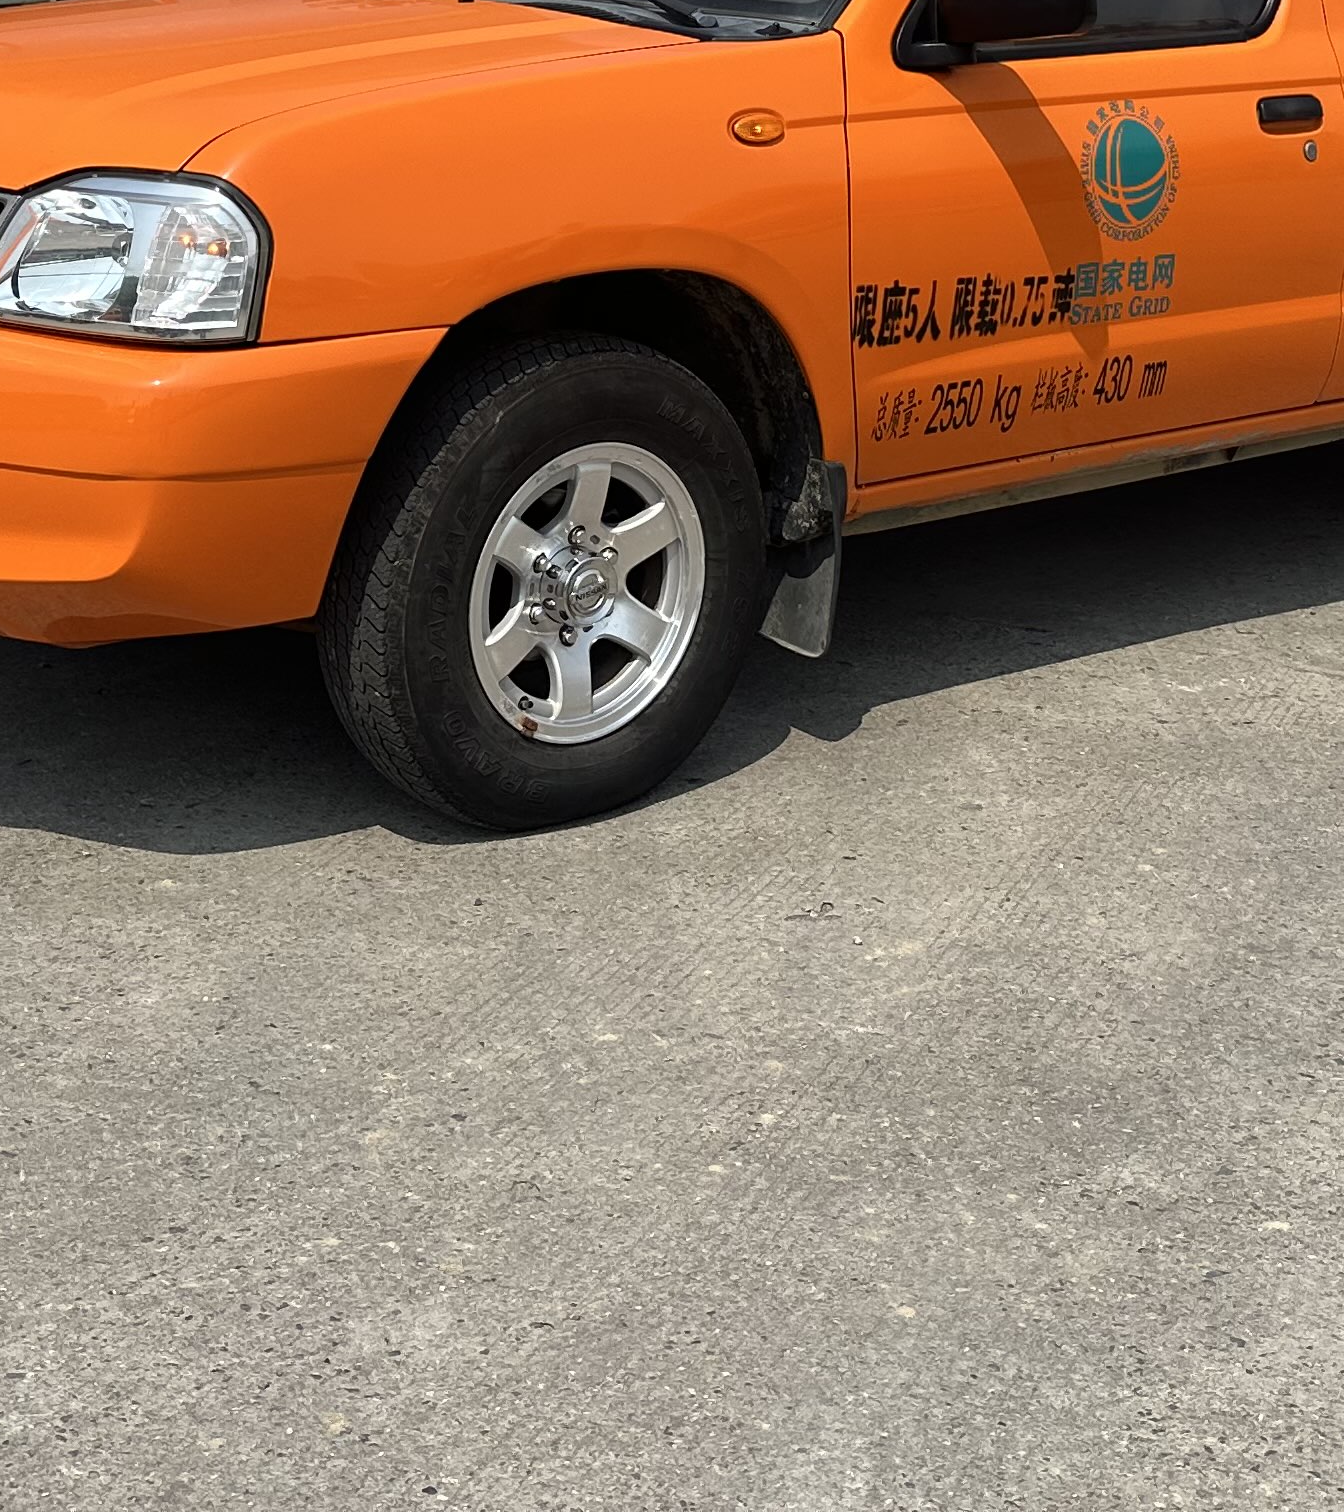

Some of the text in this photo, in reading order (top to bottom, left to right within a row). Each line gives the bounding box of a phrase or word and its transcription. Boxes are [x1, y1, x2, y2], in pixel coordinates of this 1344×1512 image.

[1074, 253, 1176, 300] 国家电网
[852, 279, 941, 349] 限座5人
[923, 377, 985, 436] 2550
[989, 374, 1022, 433] kg
[1092, 354, 1134, 406] 430
[1138, 359, 1169, 400] mm
